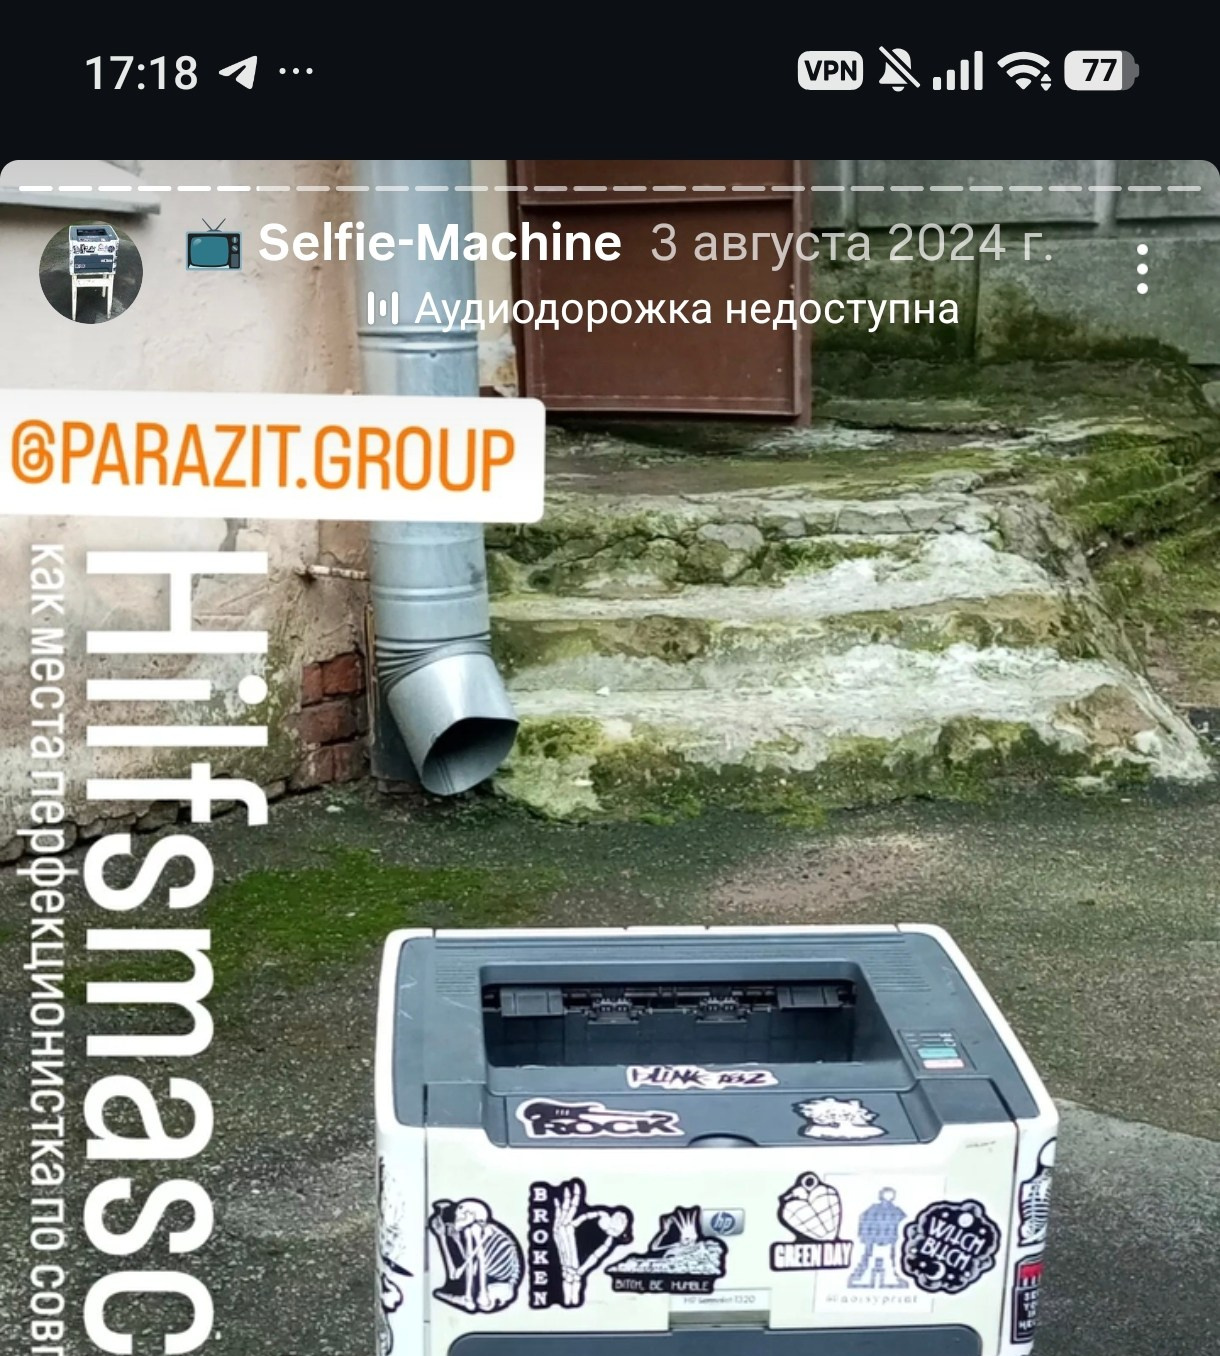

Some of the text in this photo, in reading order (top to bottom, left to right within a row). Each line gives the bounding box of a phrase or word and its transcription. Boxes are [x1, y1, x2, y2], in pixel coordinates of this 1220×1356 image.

[533, 1187, 549, 1306] BROKEN
[774, 1242, 853, 1268] GREEN DAY
